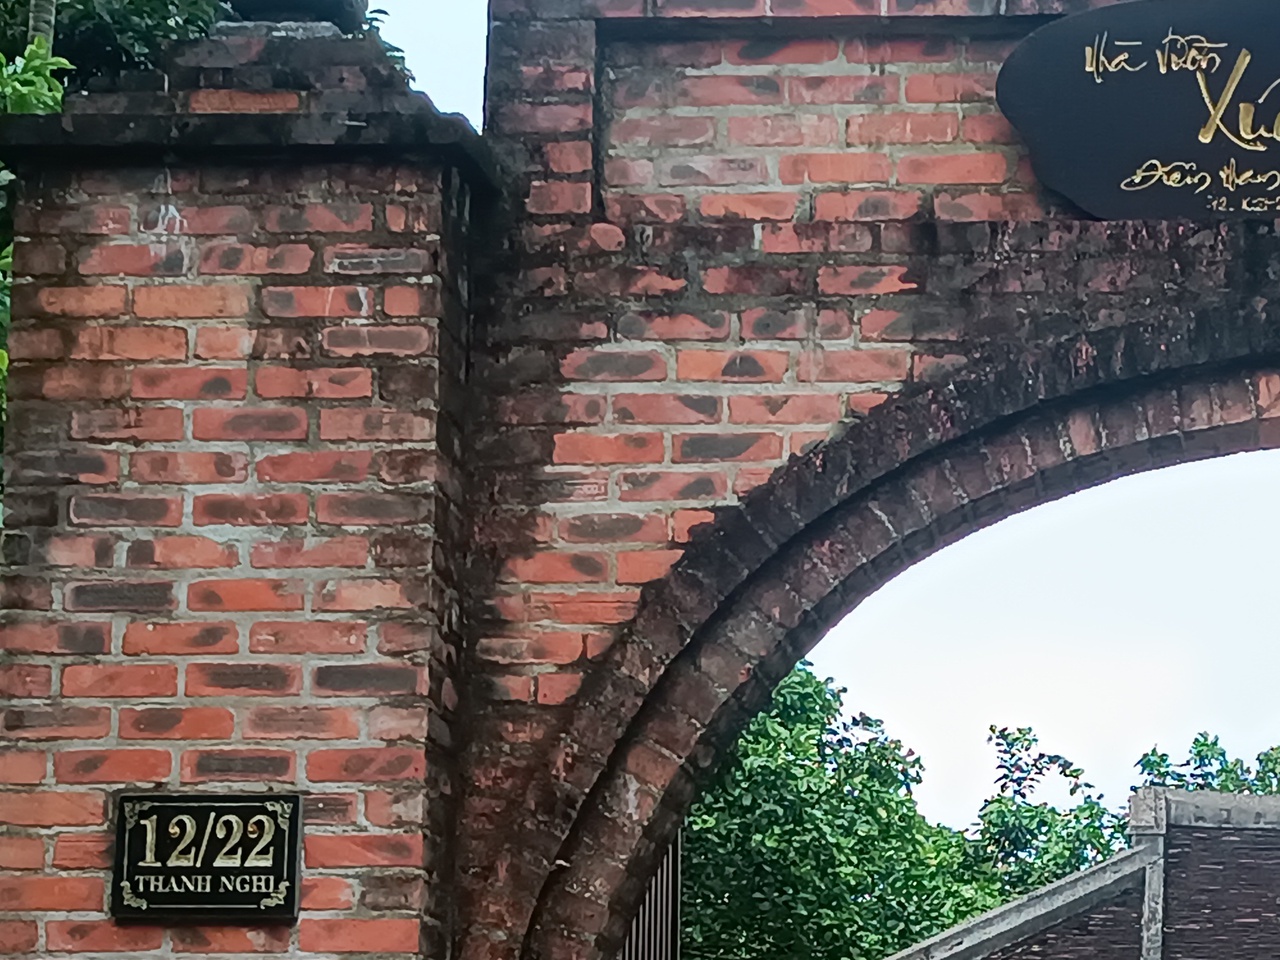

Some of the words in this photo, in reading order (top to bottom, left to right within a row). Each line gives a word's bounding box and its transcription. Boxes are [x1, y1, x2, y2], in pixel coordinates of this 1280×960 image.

[1085, 30, 1147, 84] Nhà
[137, 812, 276, 868] 12/22
[134, 875, 212, 893] THANH
